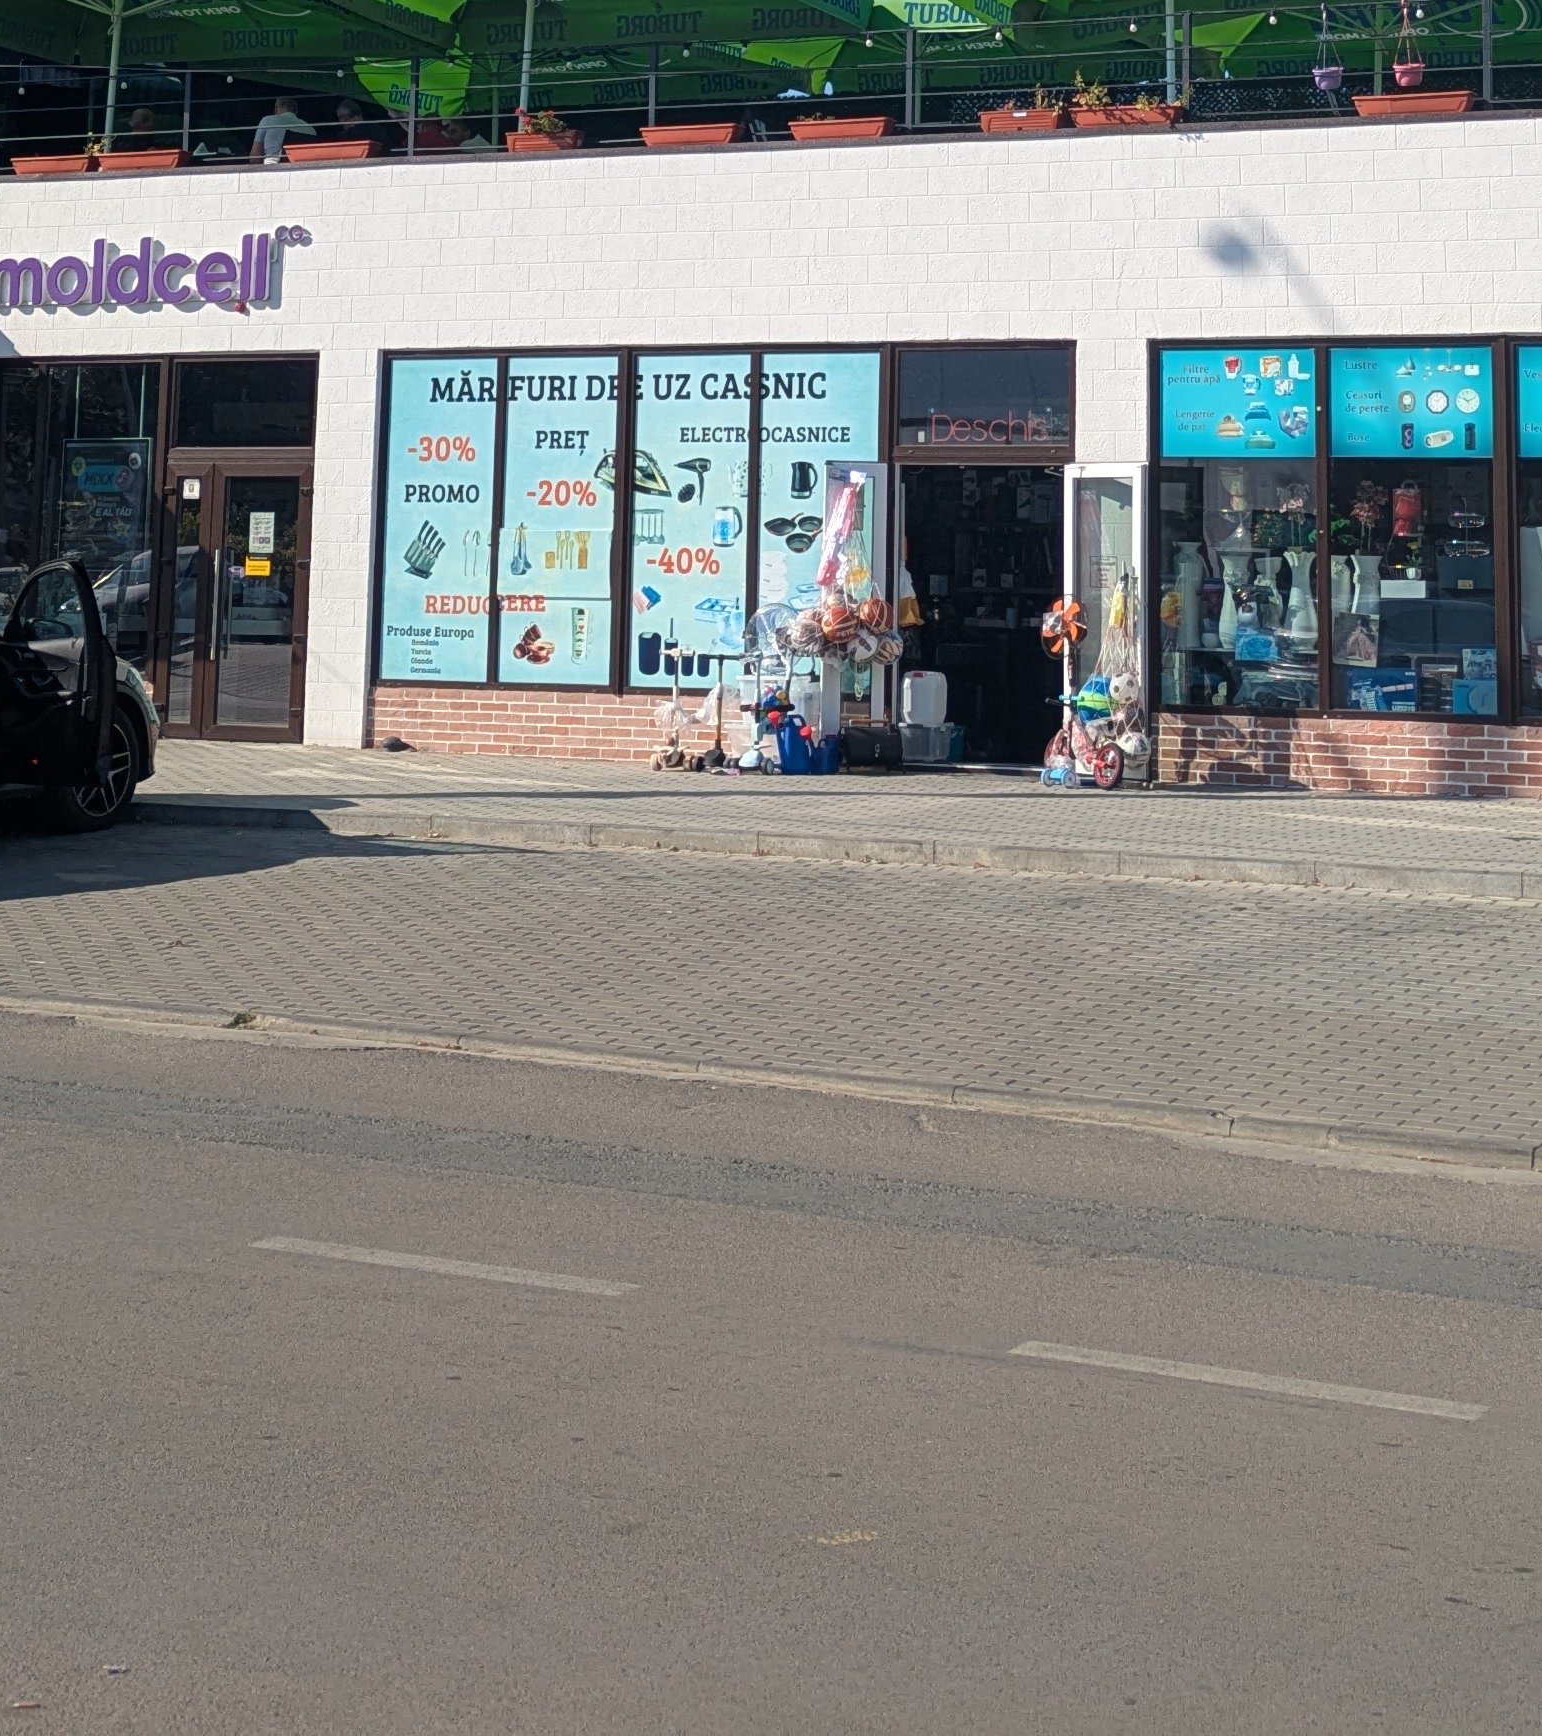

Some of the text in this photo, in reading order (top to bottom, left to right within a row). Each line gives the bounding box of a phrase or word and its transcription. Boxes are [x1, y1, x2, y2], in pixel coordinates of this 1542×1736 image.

[274, 224, 304, 242] CG
[1183, 365, 1209, 374] Filtre
[1344, 360, 1378, 370] Lustre
[430, 370, 577, 404] MĂRFURI
[653, 374, 691, 400] UZ
[1167, 374, 1221, 386] pentru apă
[1345, 390, 1382, 400] Ceasuri
[1175, 409, 1215, 422] Lengerie
[1345, 402, 1389, 415] de perete
[1177, 422, 1207, 433] de pat
[535, 430, 589, 456] PREȚ
[1347, 432, 1370, 442] Boxe
[407, 436, 476, 462] -30%
[404, 484, 480, 503] PROMO
[526, 480, 597, 507] -20%
[646, 547, 721, 575] -40%
[425, 594, 546, 615] REDUCERE
[387, 625, 474, 640] Produse Europa
